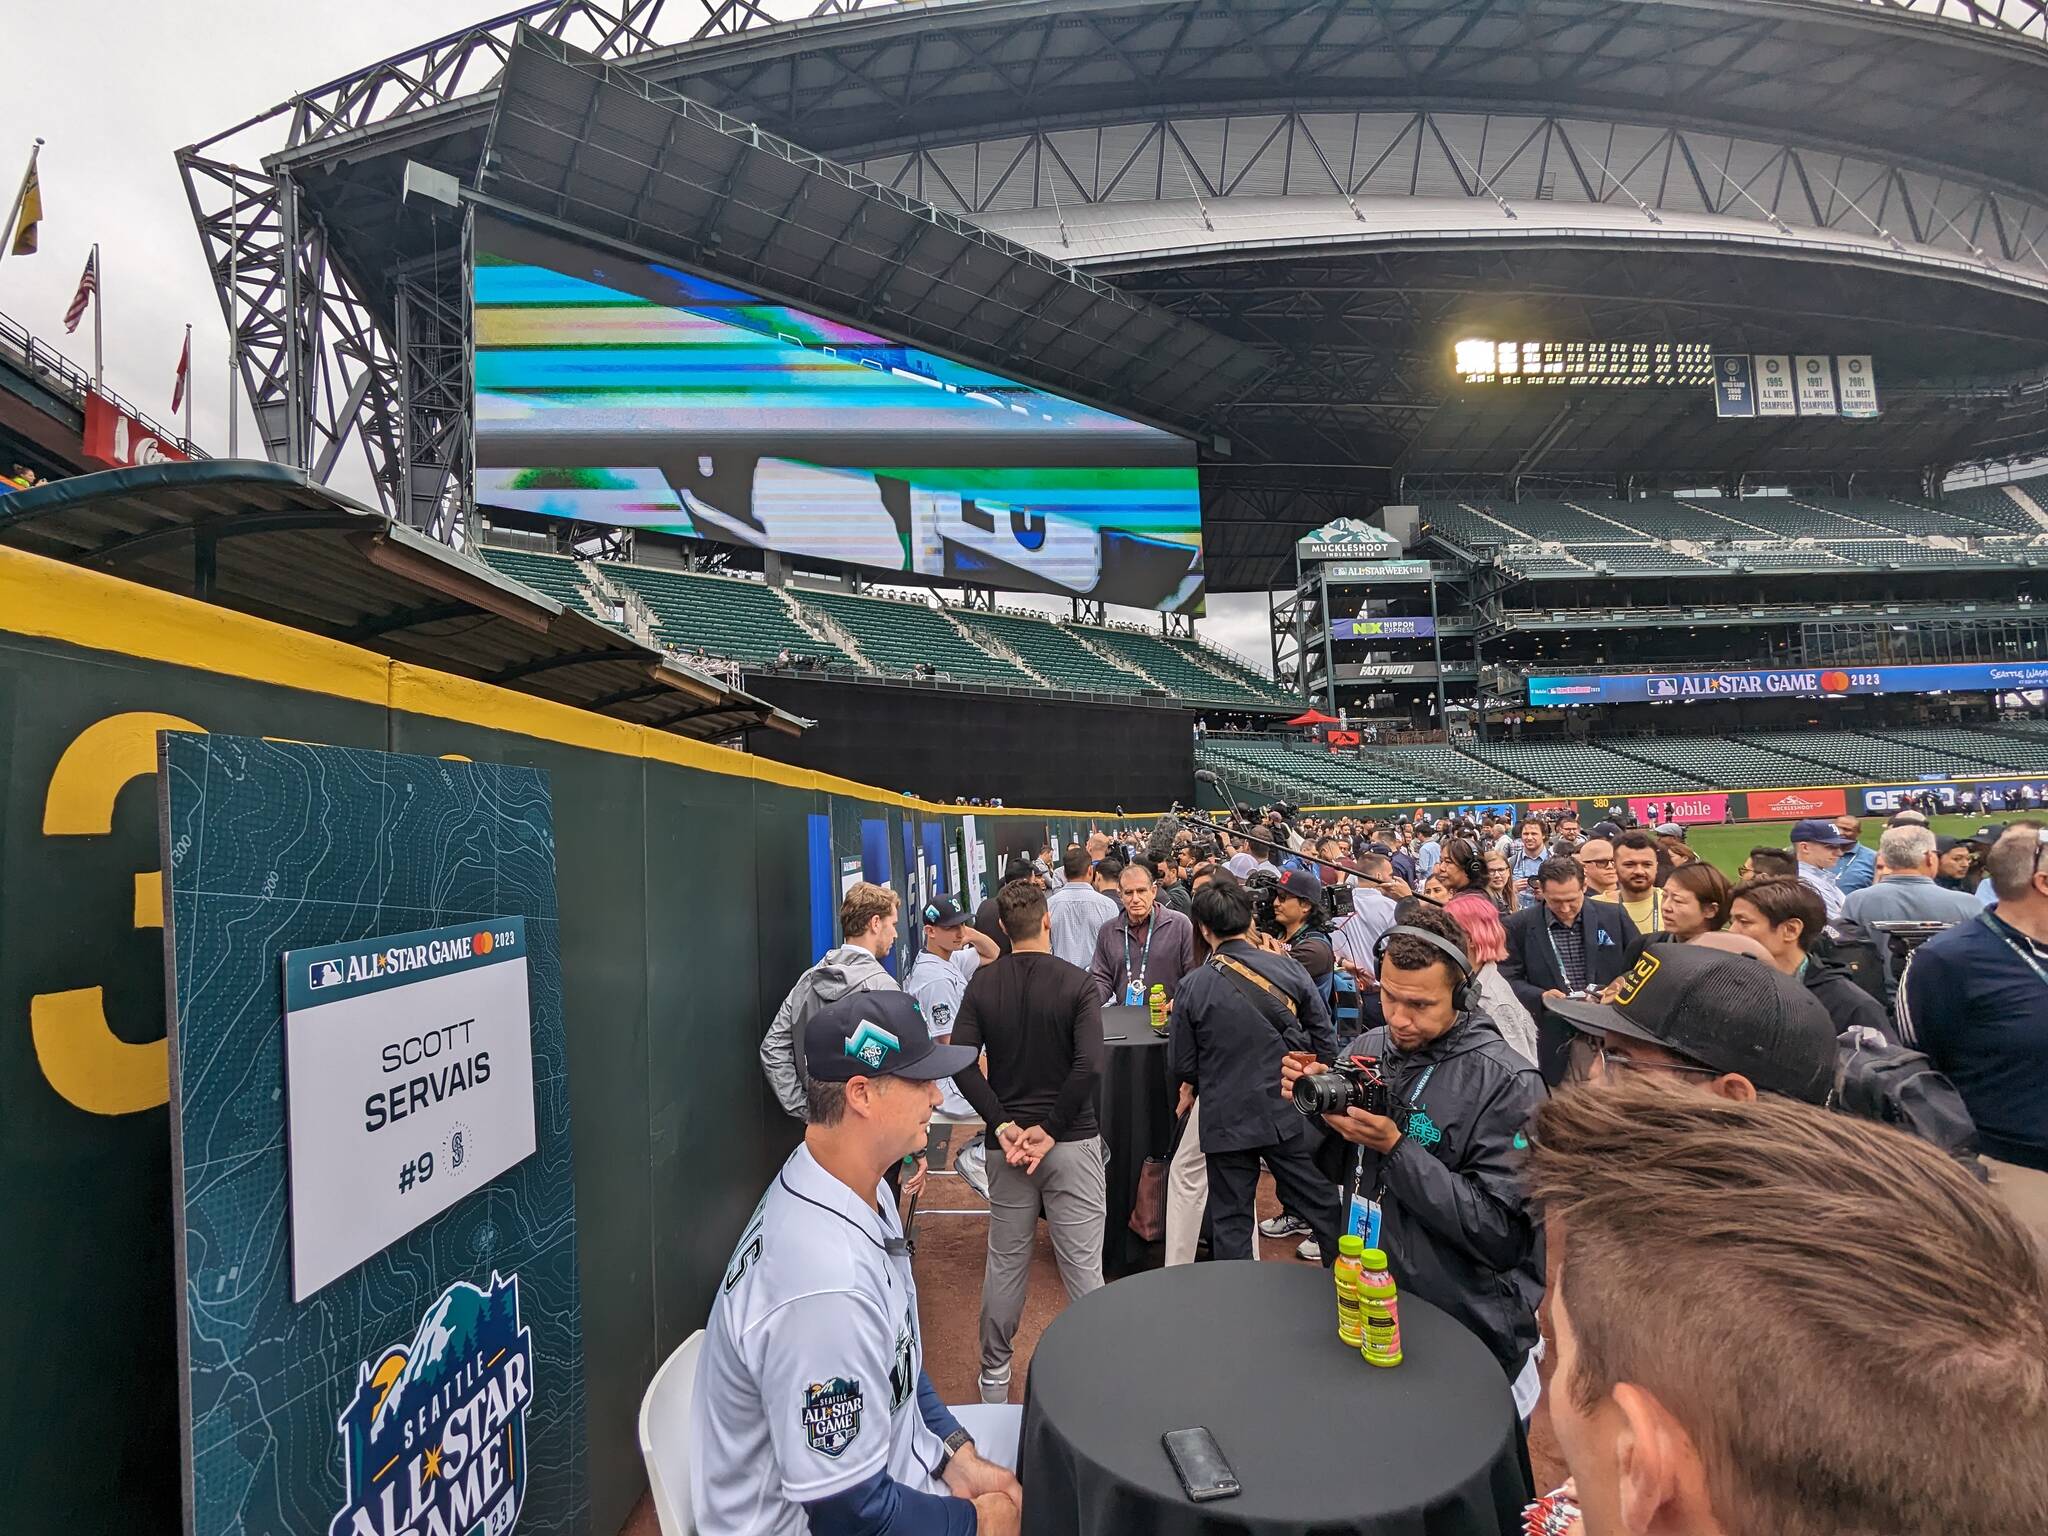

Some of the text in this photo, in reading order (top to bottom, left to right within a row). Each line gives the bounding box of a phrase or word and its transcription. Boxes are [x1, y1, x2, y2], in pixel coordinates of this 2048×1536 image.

[1774, 390, 1788, 398] WEST
[1814, 390, 1829, 398] WEST
[1856, 390, 1870, 398] WEST
[1761, 401, 1793, 410] CHAMPIONS
[1801, 401, 1834, 410] CHAMPIONS
[1311, 543, 1388, 553] MUCKLESHOOT
[1381, 664, 1414, 675] TWITCH
[1766, 673, 1818, 692] GAME
[1851, 673, 1881, 686] 2023
[1593, 798, 1609, 808] 380
[1866, 787, 1955, 811] GEO
[428, 936, 473, 965] GAME
[494, 930, 516, 949] 2023
[381, 1018, 476, 1073] SCOTT
[364, 1051, 491, 1133] SERVAIS
[398, 1151, 435, 1195] #9
[403, 1350, 484, 1449] SEATTLE
[820, 1393, 847, 1406] SEATTLE
[816, 1413, 853, 1435] GAME
[393, 1435, 503, 1536] AME
[491, 1500, 508, 1533] 23
